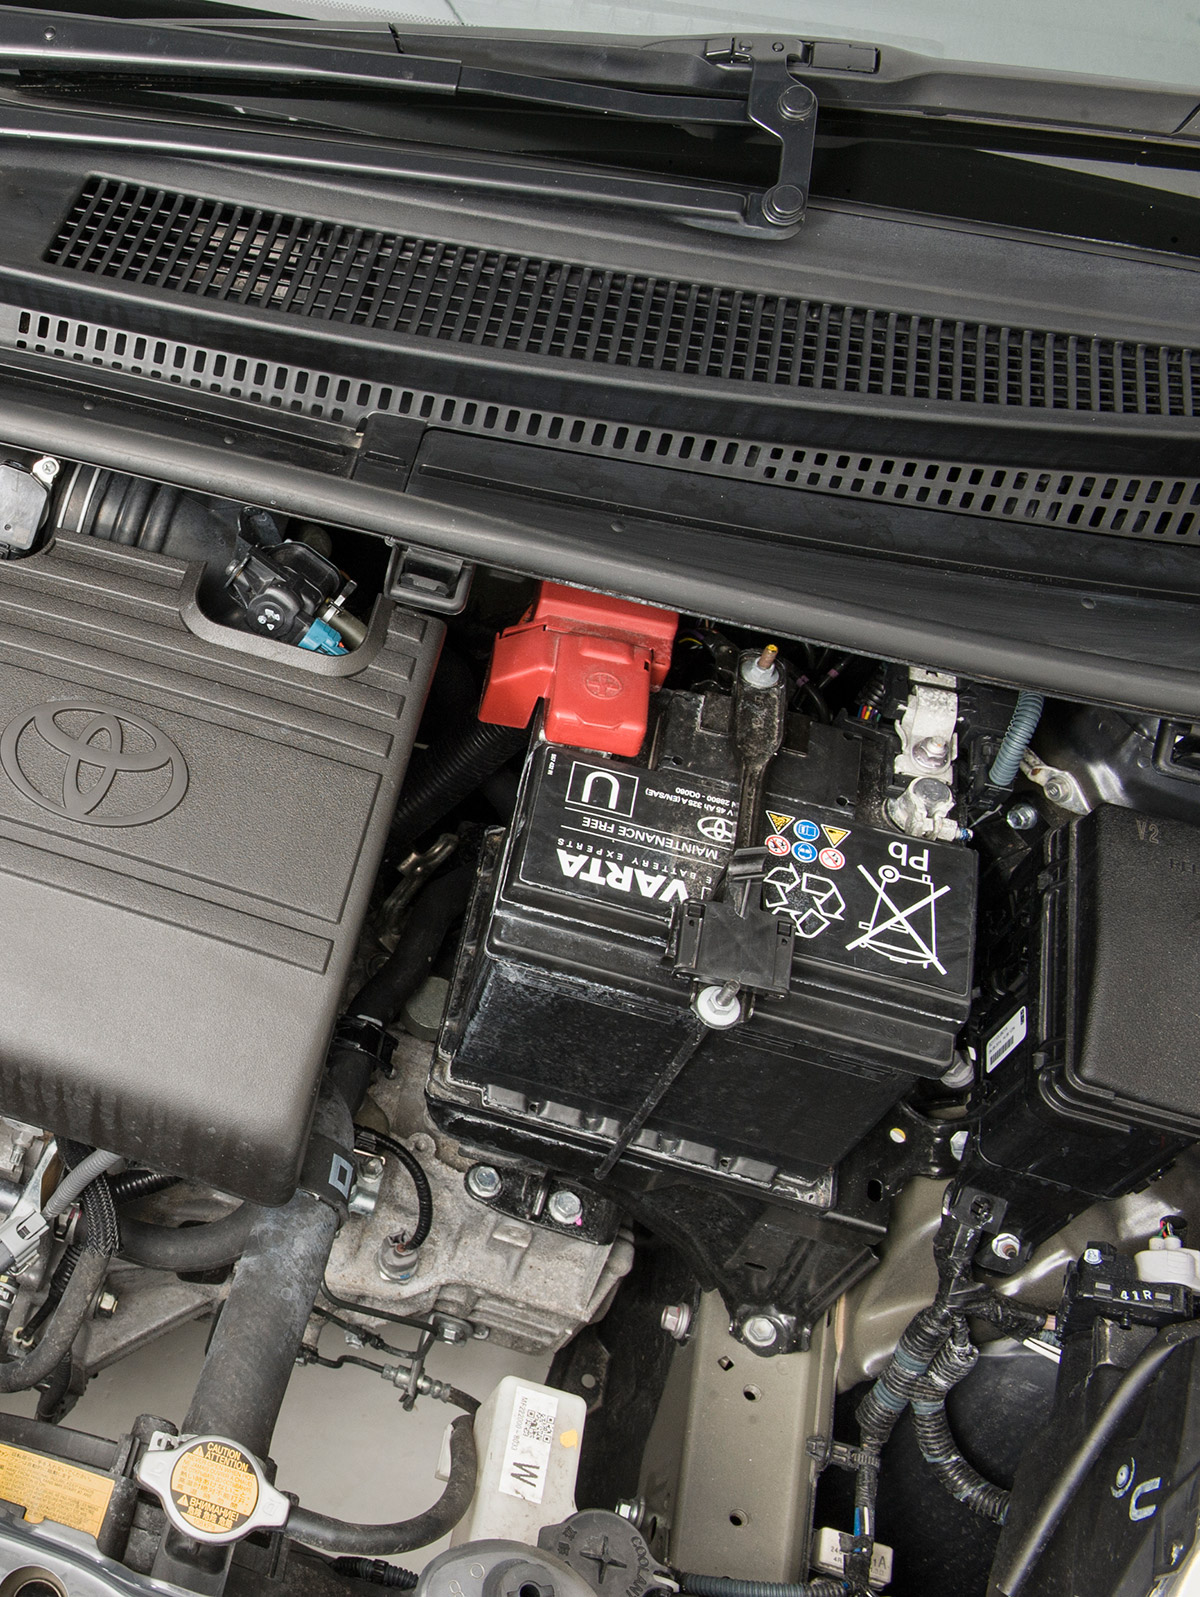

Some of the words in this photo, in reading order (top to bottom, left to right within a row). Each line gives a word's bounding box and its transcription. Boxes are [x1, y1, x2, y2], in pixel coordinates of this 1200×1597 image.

[581, 770, 620, 810] U
[704, 803, 716, 812] Ah
[582, 816, 616, 833] FREE
[557, 838, 624, 860] EXPERTS
[618, 829, 719, 860] MAINTENANCE
[888, 841, 929, 872] Pb
[556, 848, 689, 902] VARTA
[632, 859, 697, 880] BATTERY
[1120, 1288, 1154, 1302] 41R
[204, 1451, 248, 1472] ATTENTION
[206, 1442, 241, 1460] CAUTION
[510, 1462, 540, 1488] W
[189, 1497, 240, 1522] ВНИМАНИЕ!
